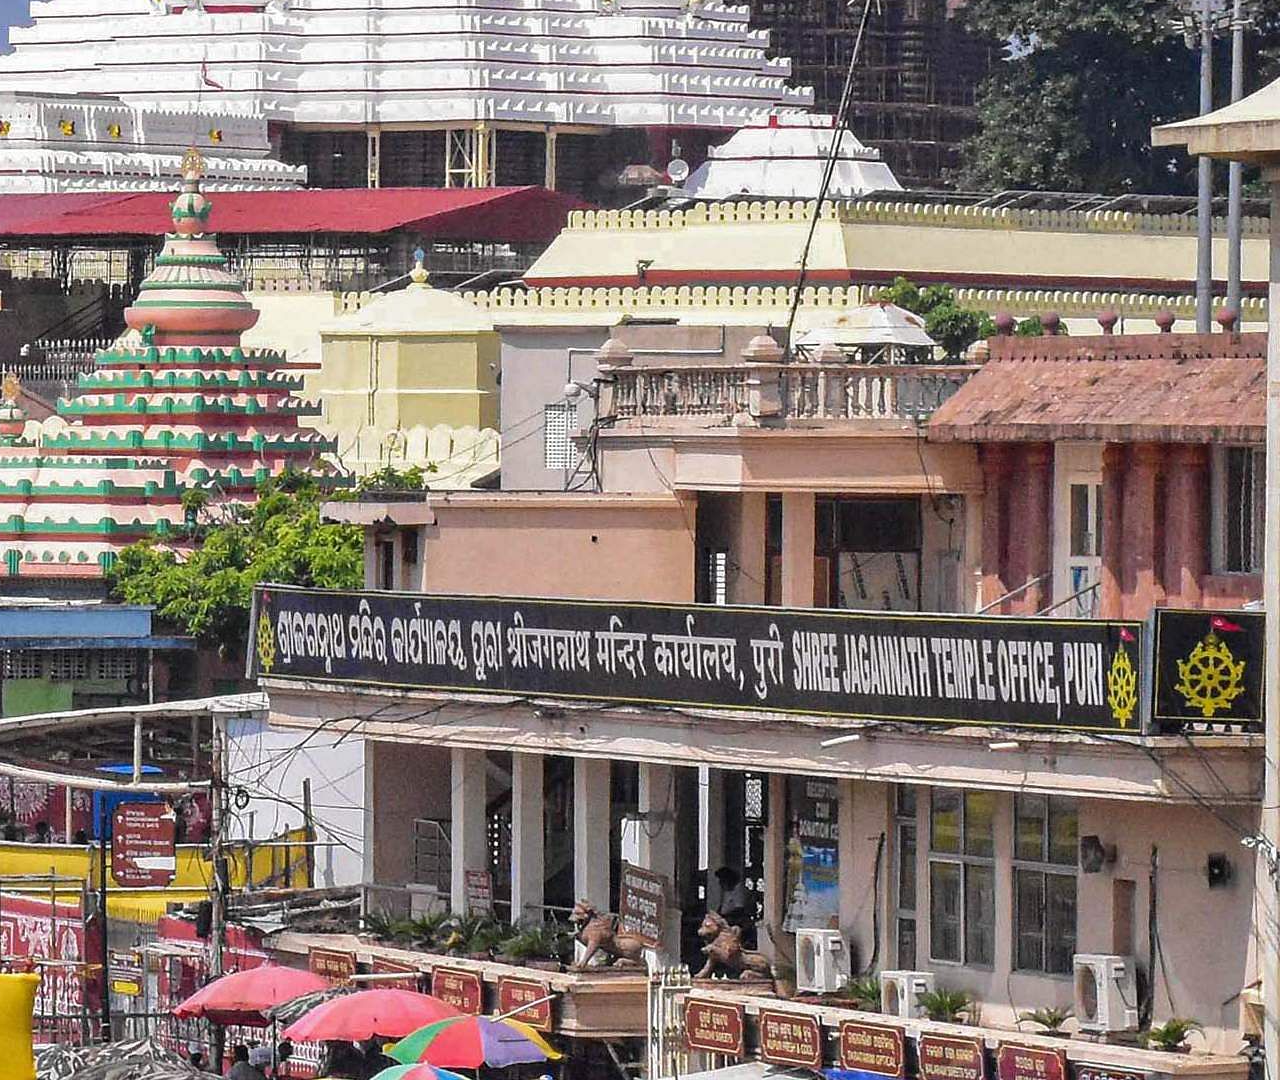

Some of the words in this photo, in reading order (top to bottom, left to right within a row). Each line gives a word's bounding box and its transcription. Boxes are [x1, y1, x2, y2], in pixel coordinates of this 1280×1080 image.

[349, 599, 388, 665] ମନ୍ଦିର
[471, 620, 503, 681] ପୁରୀ
[506, 611, 591, 672] श्रीजगन्नाथ
[595, 615, 648, 680] मन्दिर
[652, 614, 745, 691] कार्यालय,
[750, 623, 785, 700] पुरी
[792, 630, 840, 693] SHREE
[842, 633, 932, 698] JAGANNATH
[931, 636, 996, 701] TEMPLE
[997, 639, 1062, 720] OFFICE,
[1063, 642, 1104, 706] PURI
[798, 818, 829, 839] DONATION
